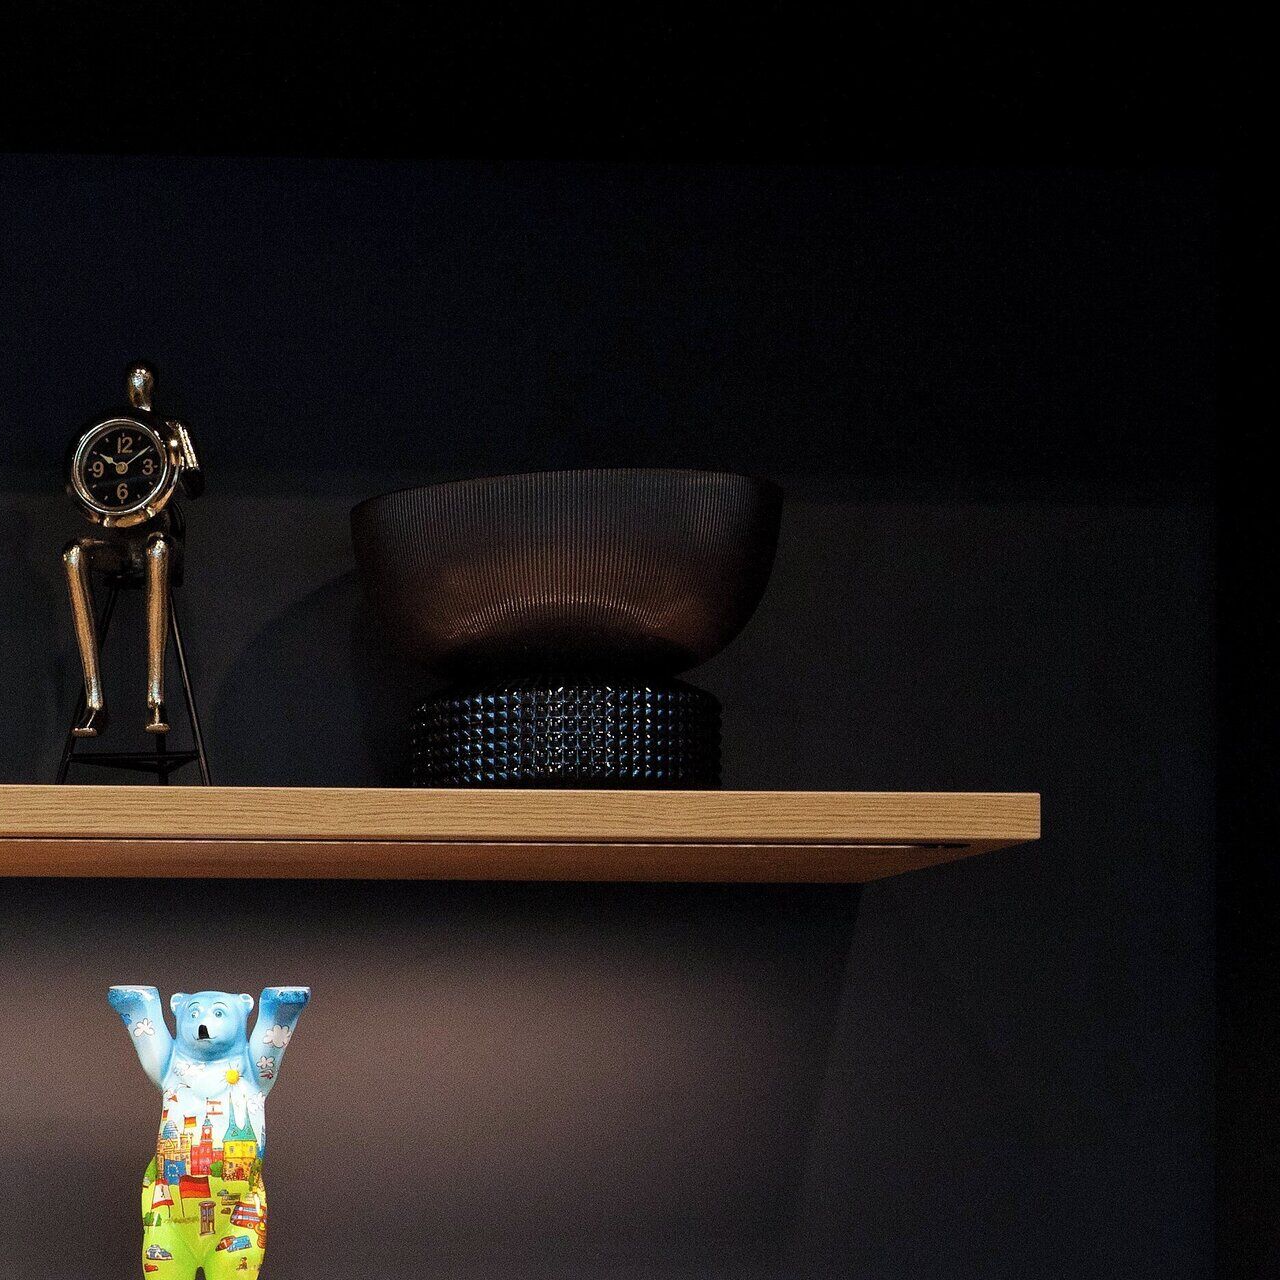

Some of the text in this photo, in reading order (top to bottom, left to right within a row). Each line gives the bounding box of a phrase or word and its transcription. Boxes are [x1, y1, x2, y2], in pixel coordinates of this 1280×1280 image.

[117, 436, 133, 454] 12
[92, 461, 105, 478] 9
[142, 459, 154, 476] 3
[116, 483, 129, 500] 6
